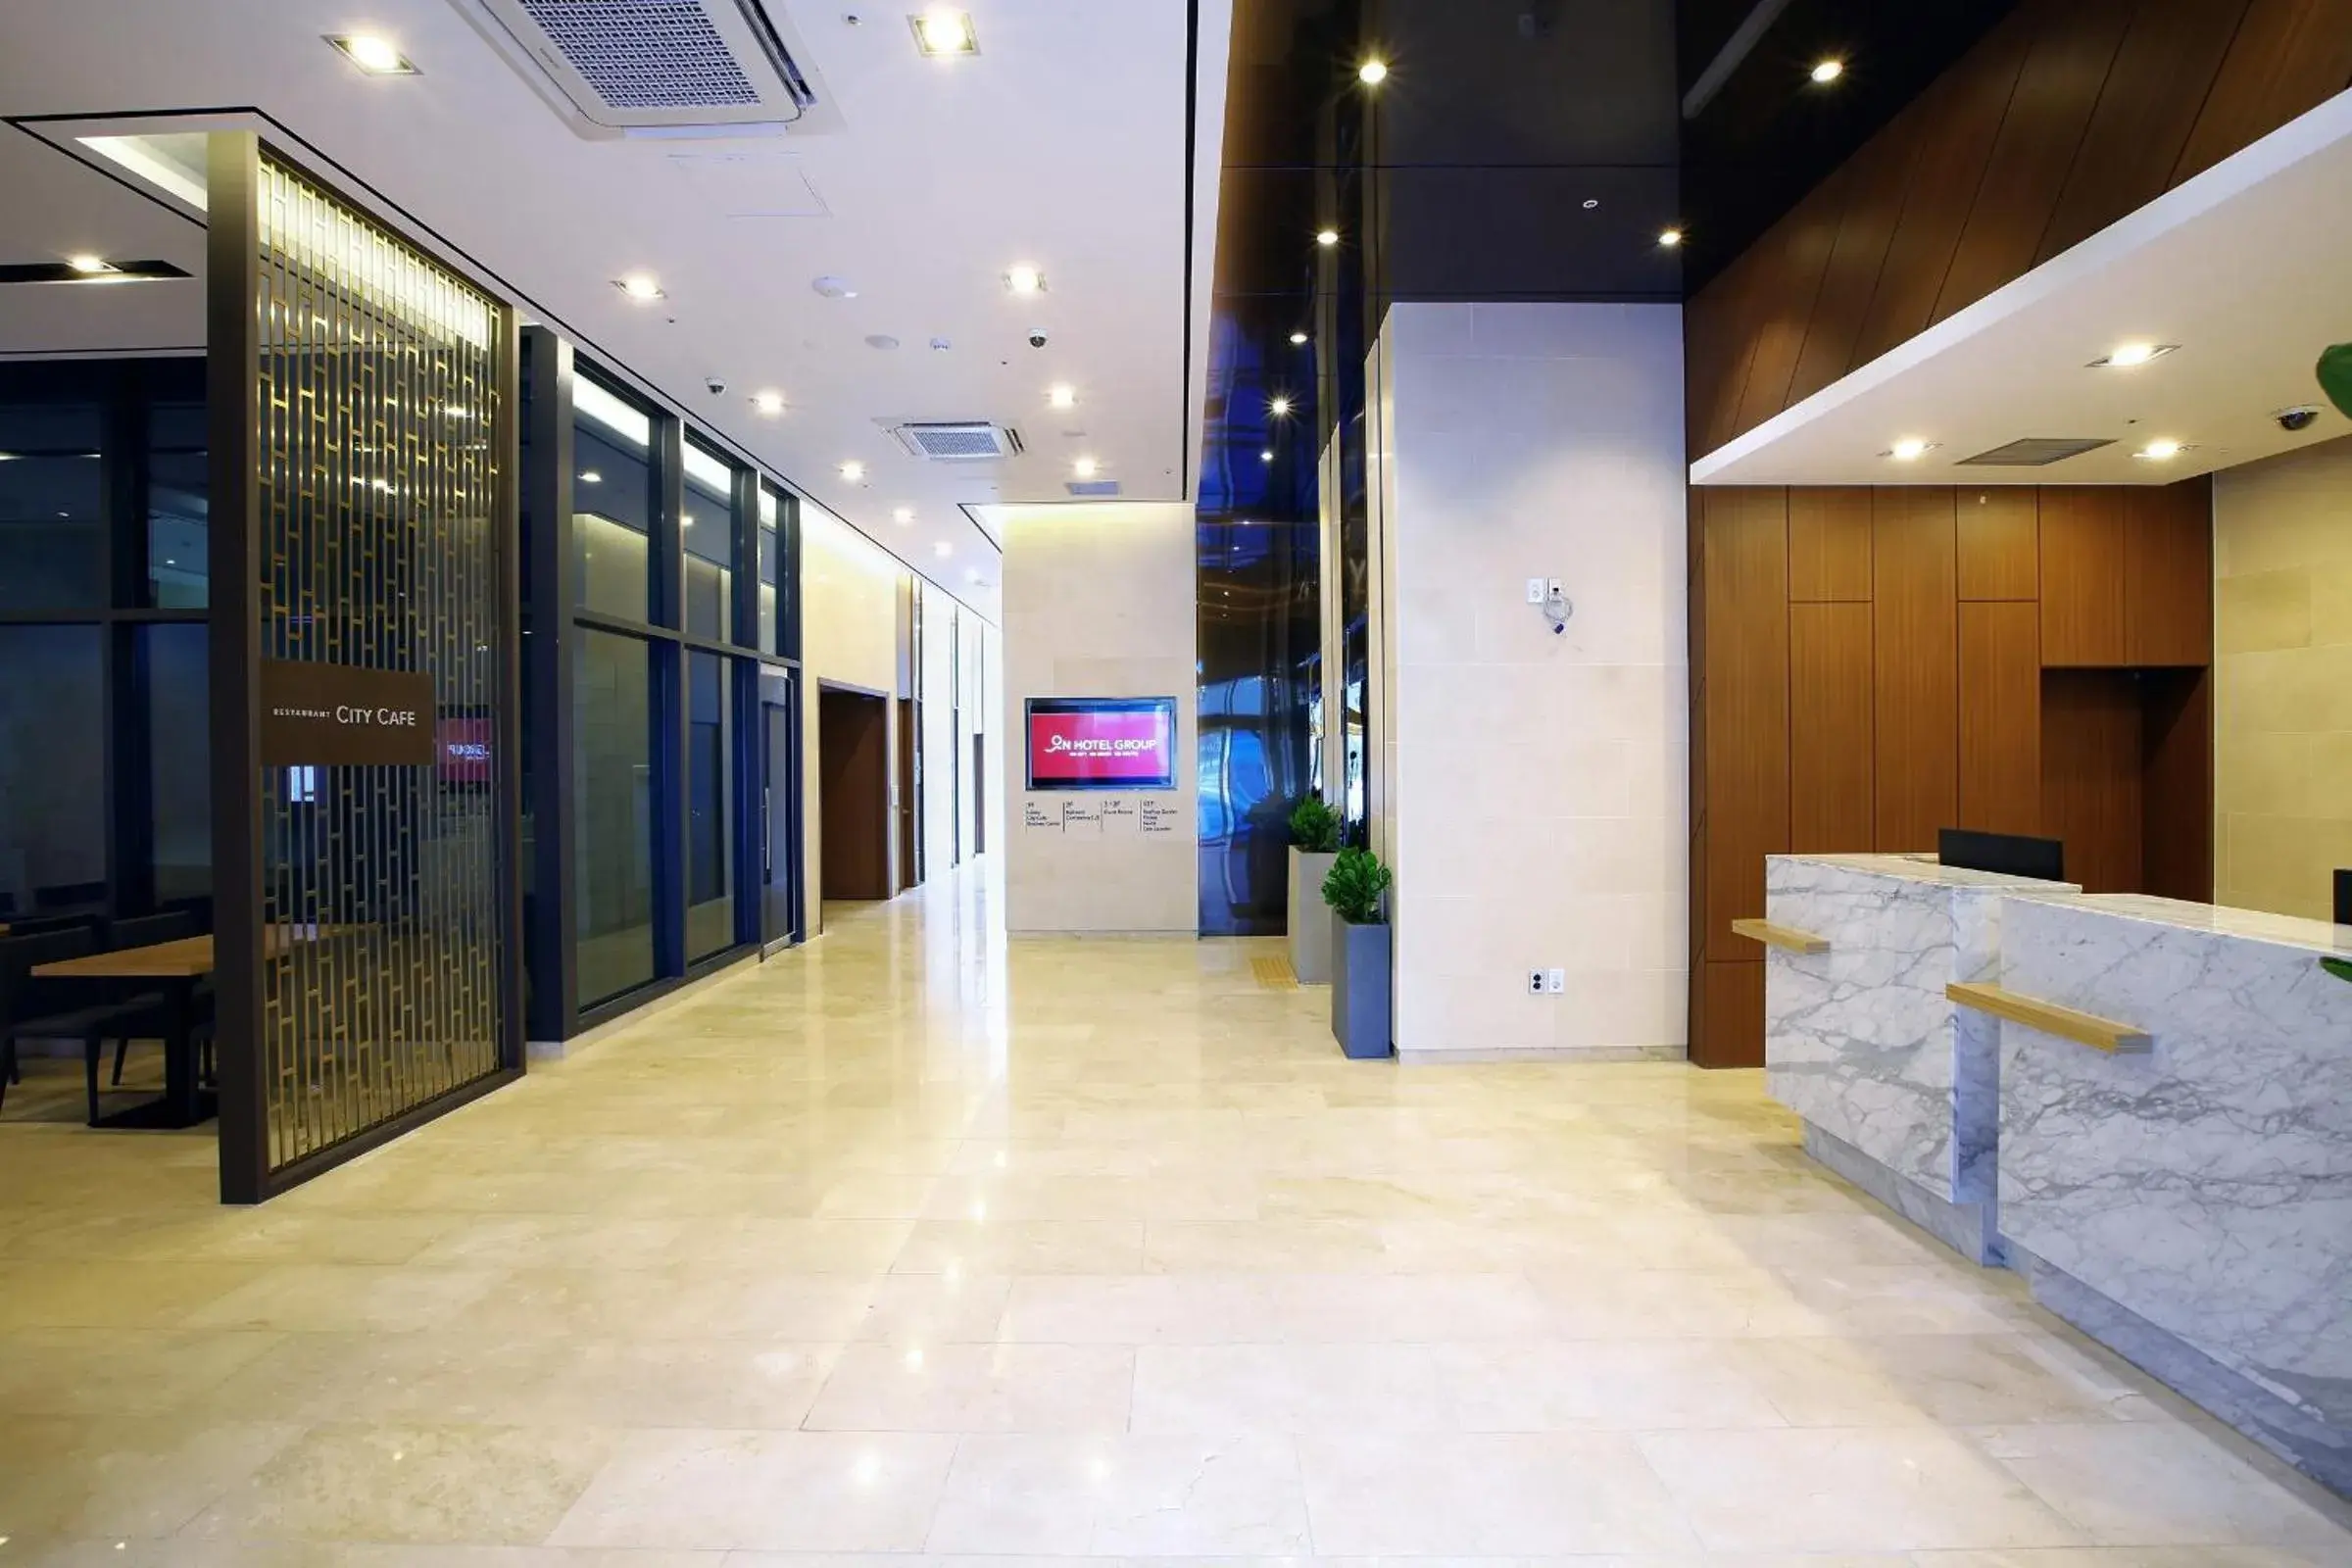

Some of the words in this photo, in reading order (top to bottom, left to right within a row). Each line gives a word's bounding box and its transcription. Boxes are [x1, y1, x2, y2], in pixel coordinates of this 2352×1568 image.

[272, 708, 331, 718] RESTAURANT
[336, 706, 373, 723] CITY
[377, 709, 416, 726] CAFE
[1074, 739, 1112, 751] HOTEL
[1114, 739, 1157, 751] GROUP
